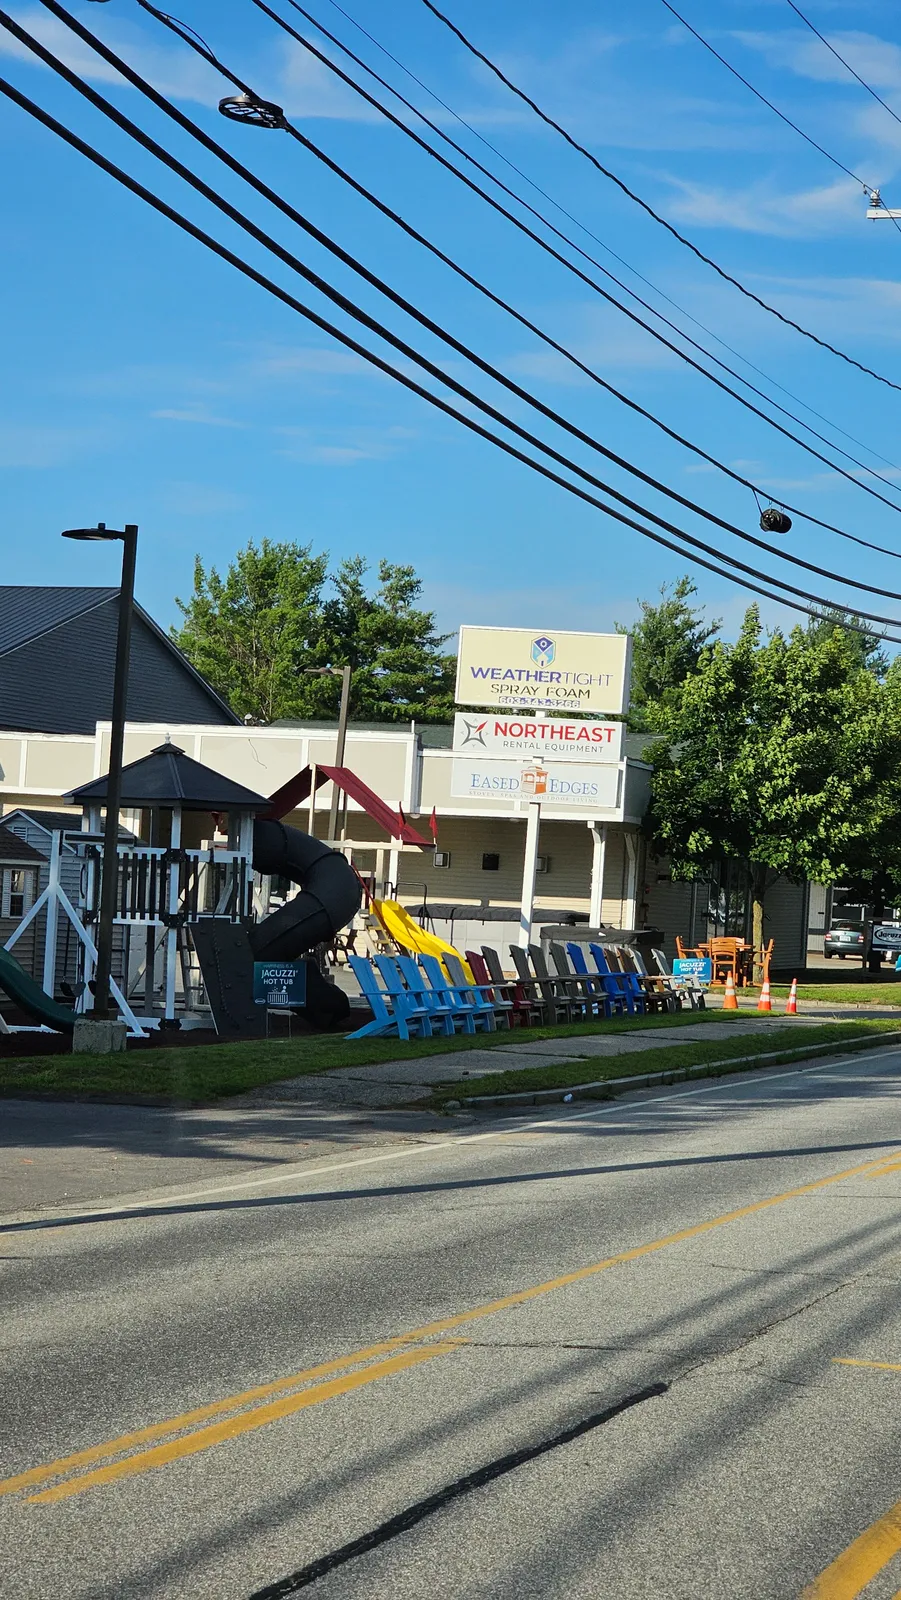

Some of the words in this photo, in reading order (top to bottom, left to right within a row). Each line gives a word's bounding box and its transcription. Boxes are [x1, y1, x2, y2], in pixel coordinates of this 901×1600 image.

[470, 666, 614, 686] WEATHERTIGHT
[490, 684, 540, 696] SPRAY
[546, 687, 590, 699] FOAM
[494, 722, 616, 742] NORTHEAST
[503, 740, 540, 750] RENTAL
[545, 743, 604, 753] EQUIPMENT
[471, 773, 520, 790] EASED
[550, 778, 598, 795] EDGES
